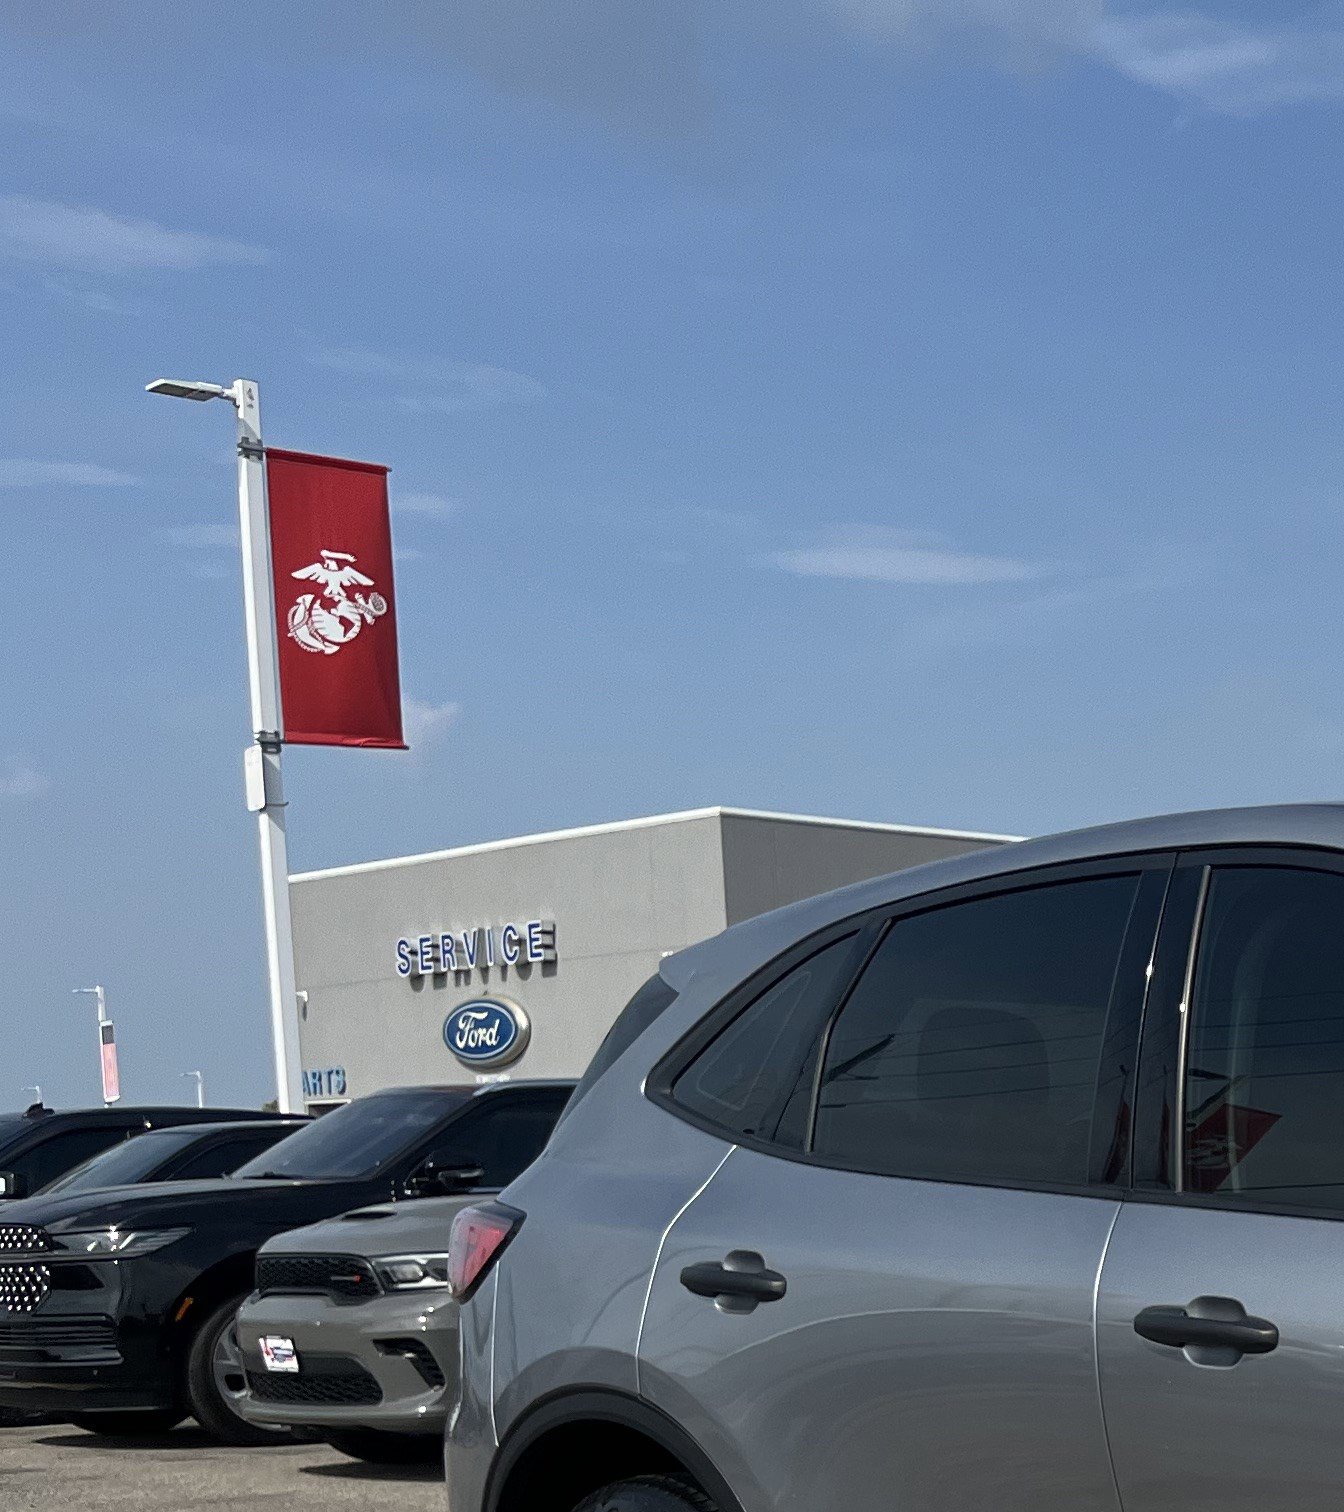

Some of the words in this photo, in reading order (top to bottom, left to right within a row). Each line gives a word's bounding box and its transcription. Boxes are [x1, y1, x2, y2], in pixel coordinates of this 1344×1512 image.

[396, 919, 545, 978] SERVICE
[455, 1010, 501, 1050] Ford
[302, 1065, 347, 1097] ARTS
